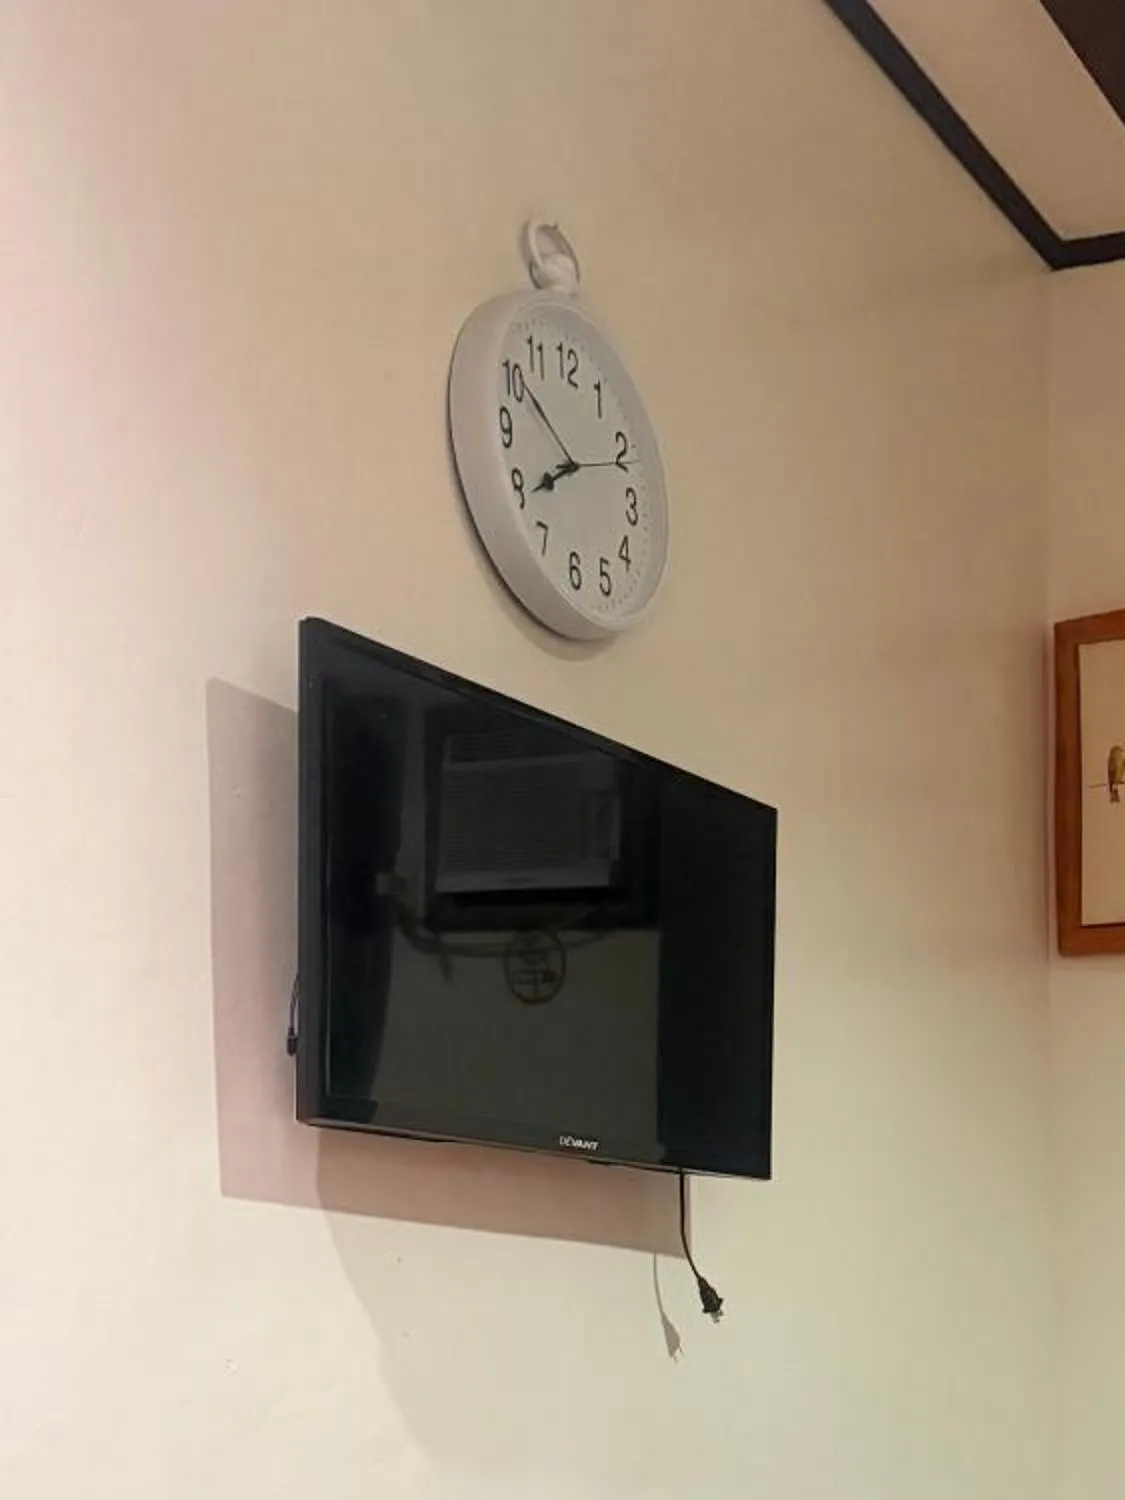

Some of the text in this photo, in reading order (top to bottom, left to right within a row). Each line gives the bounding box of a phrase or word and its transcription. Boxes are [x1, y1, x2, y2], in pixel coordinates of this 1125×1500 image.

[527, 335, 546, 380] 11
[556, 341, 579, 388] 12
[502, 359, 525, 403] 10
[593, 380, 602, 419] 1
[499, 406, 513, 449] 9
[614, 431, 629, 472] 2
[511, 467, 526, 510] 8
[625, 487, 639, 527] 3
[536, 521, 549, 557] 7
[618, 535, 631, 573] 4
[568, 550, 582, 591] 6
[599, 558, 612, 597] 5
